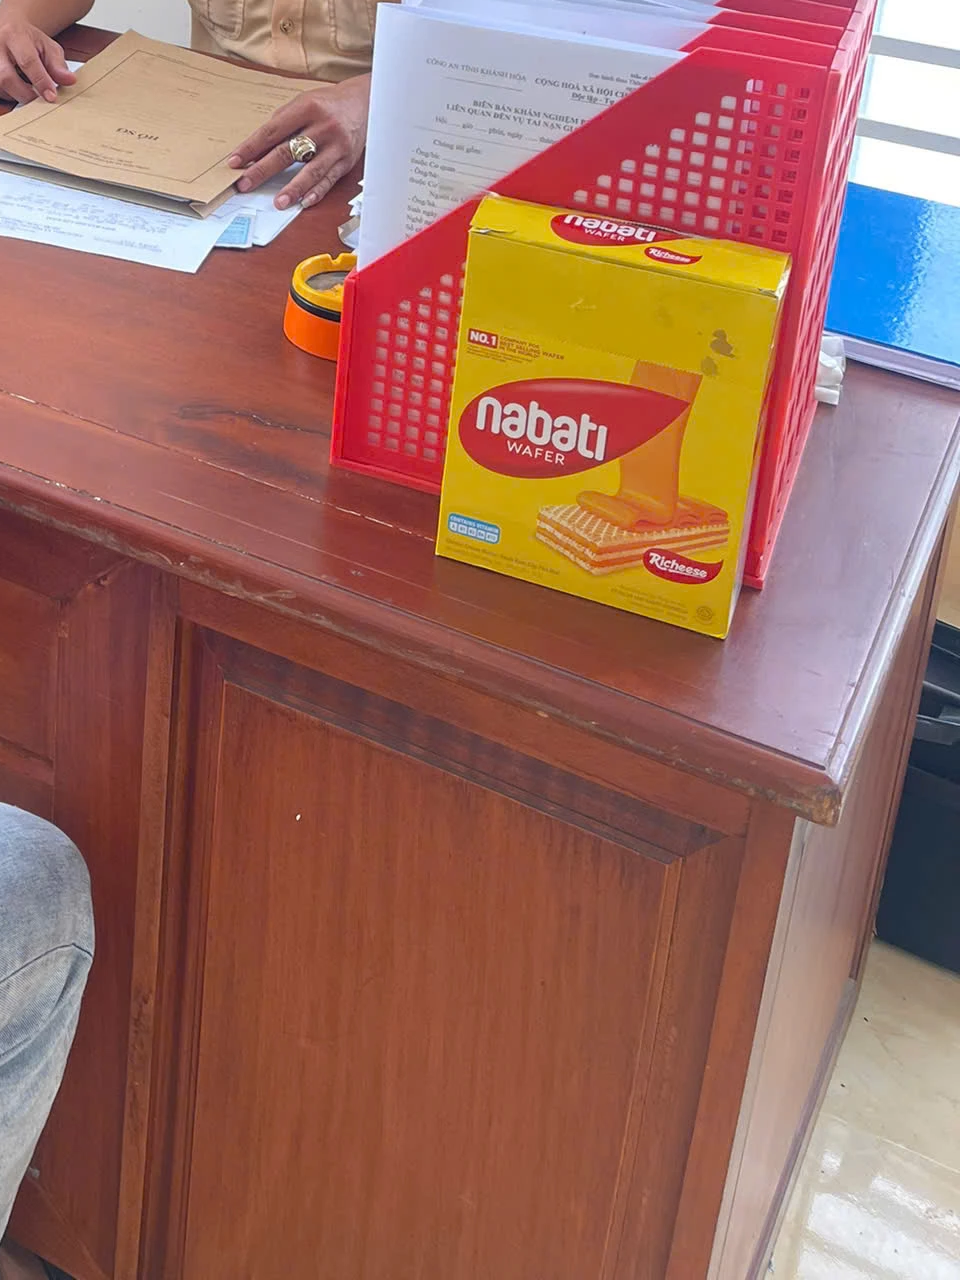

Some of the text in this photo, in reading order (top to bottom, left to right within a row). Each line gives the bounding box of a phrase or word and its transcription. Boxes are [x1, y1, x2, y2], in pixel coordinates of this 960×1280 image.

[426, 57, 447, 68] CÔNG
[535, 77, 560, 88] CỘNG
[582, 84, 595, 94] XÃ
[596, 87, 614, 98] HỘI
[446, 103, 466, 113] LIÊN
[467, 108, 492, 118] QUAN
[512, 115, 526, 125] VỤ
[527, 118, 542, 126] TAI
[473, 99, 494, 110] BIÊN
[563, 214, 657, 242] nabati
[584, 227, 626, 242] WAFER
[542, 351, 565, 360] WAFER
[475, 396, 608, 461] nabati
[507, 441, 566, 466] WAFER
[648, 552, 708, 578] Richeese
